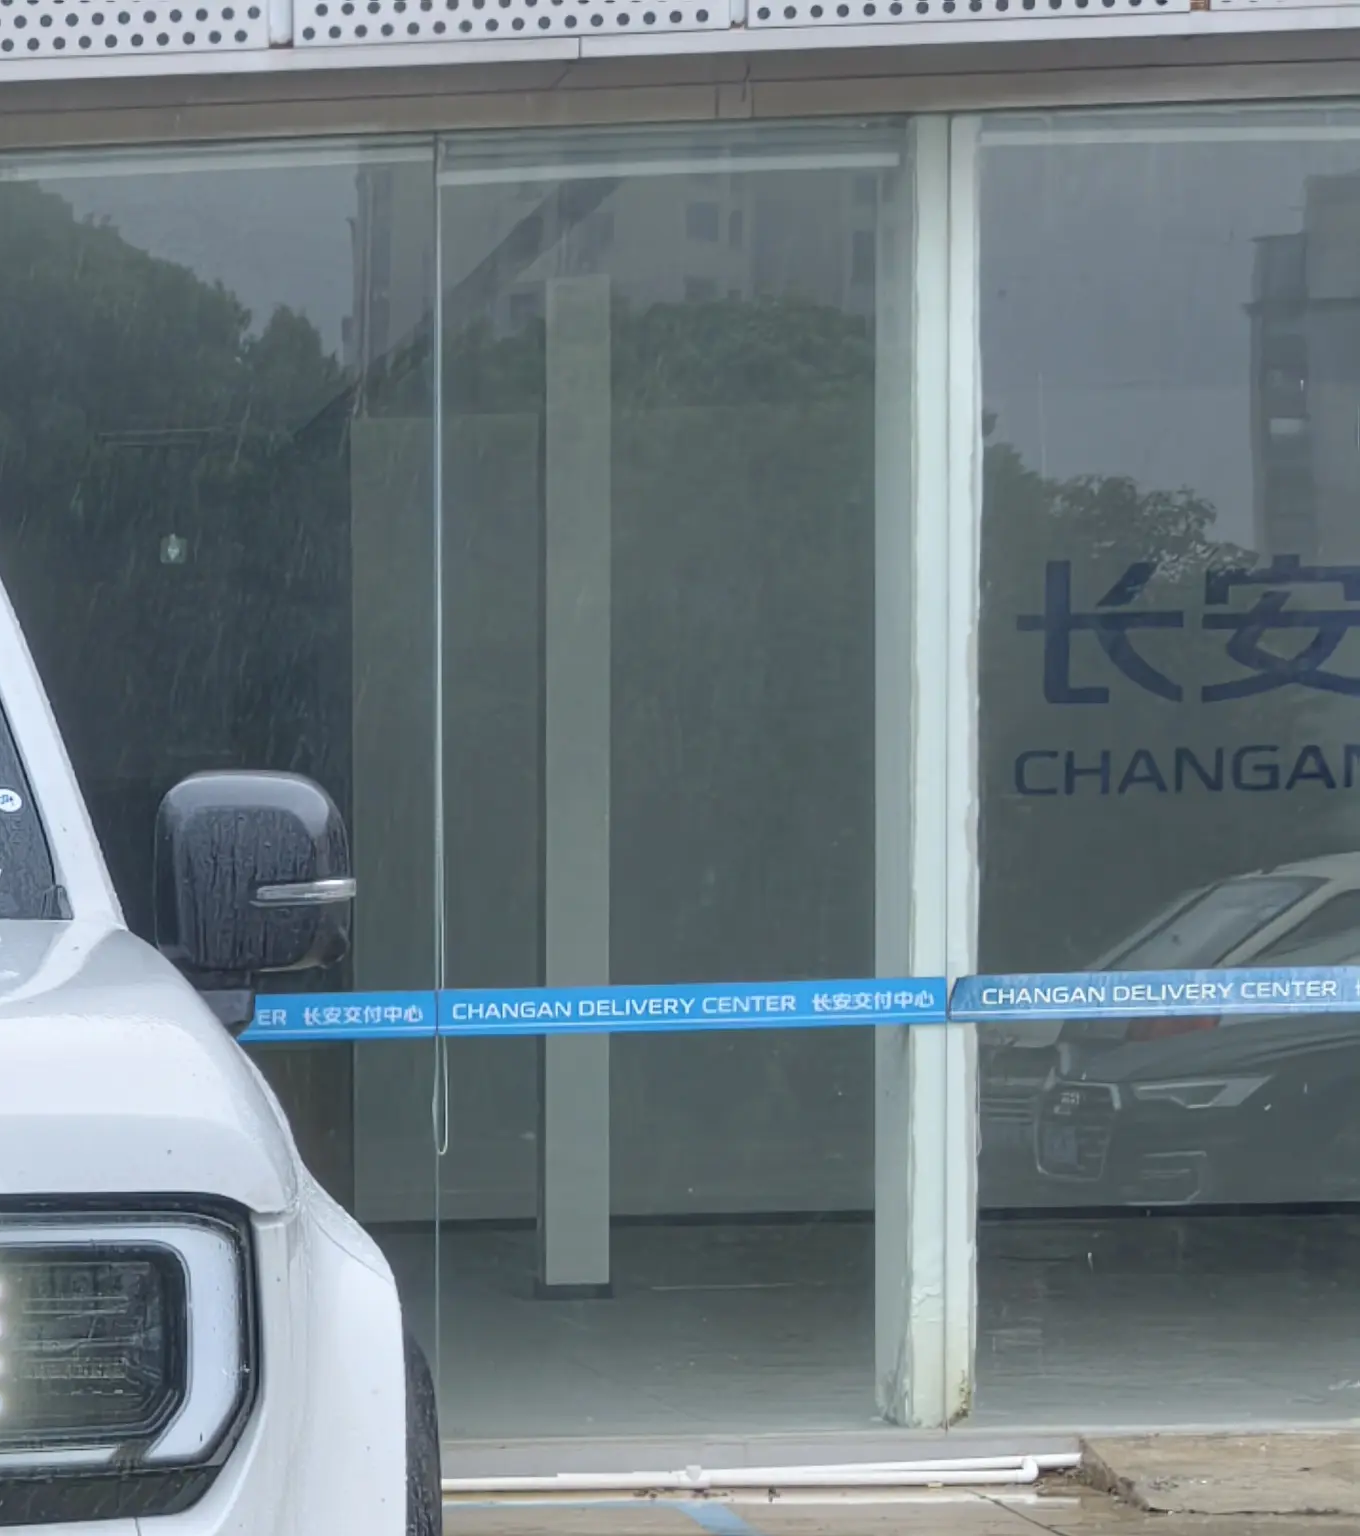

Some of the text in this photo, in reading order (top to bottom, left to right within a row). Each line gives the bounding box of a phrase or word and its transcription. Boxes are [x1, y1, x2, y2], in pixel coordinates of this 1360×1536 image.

[1016, 554, 1360, 704] 长安
[302, 1004, 424, 1027] 长安交付中心
[451, 1001, 572, 1021] CHANGAN
[578, 997, 696, 1018] DELIVERY
[701, 993, 797, 1015] CENTER
[811, 989, 935, 1012] 长安交付中心
[982, 986, 1106, 1006] CHANGAN
[1112, 982, 1234, 1003] DELIVERY
[1240, 980, 1338, 999] CENTER
